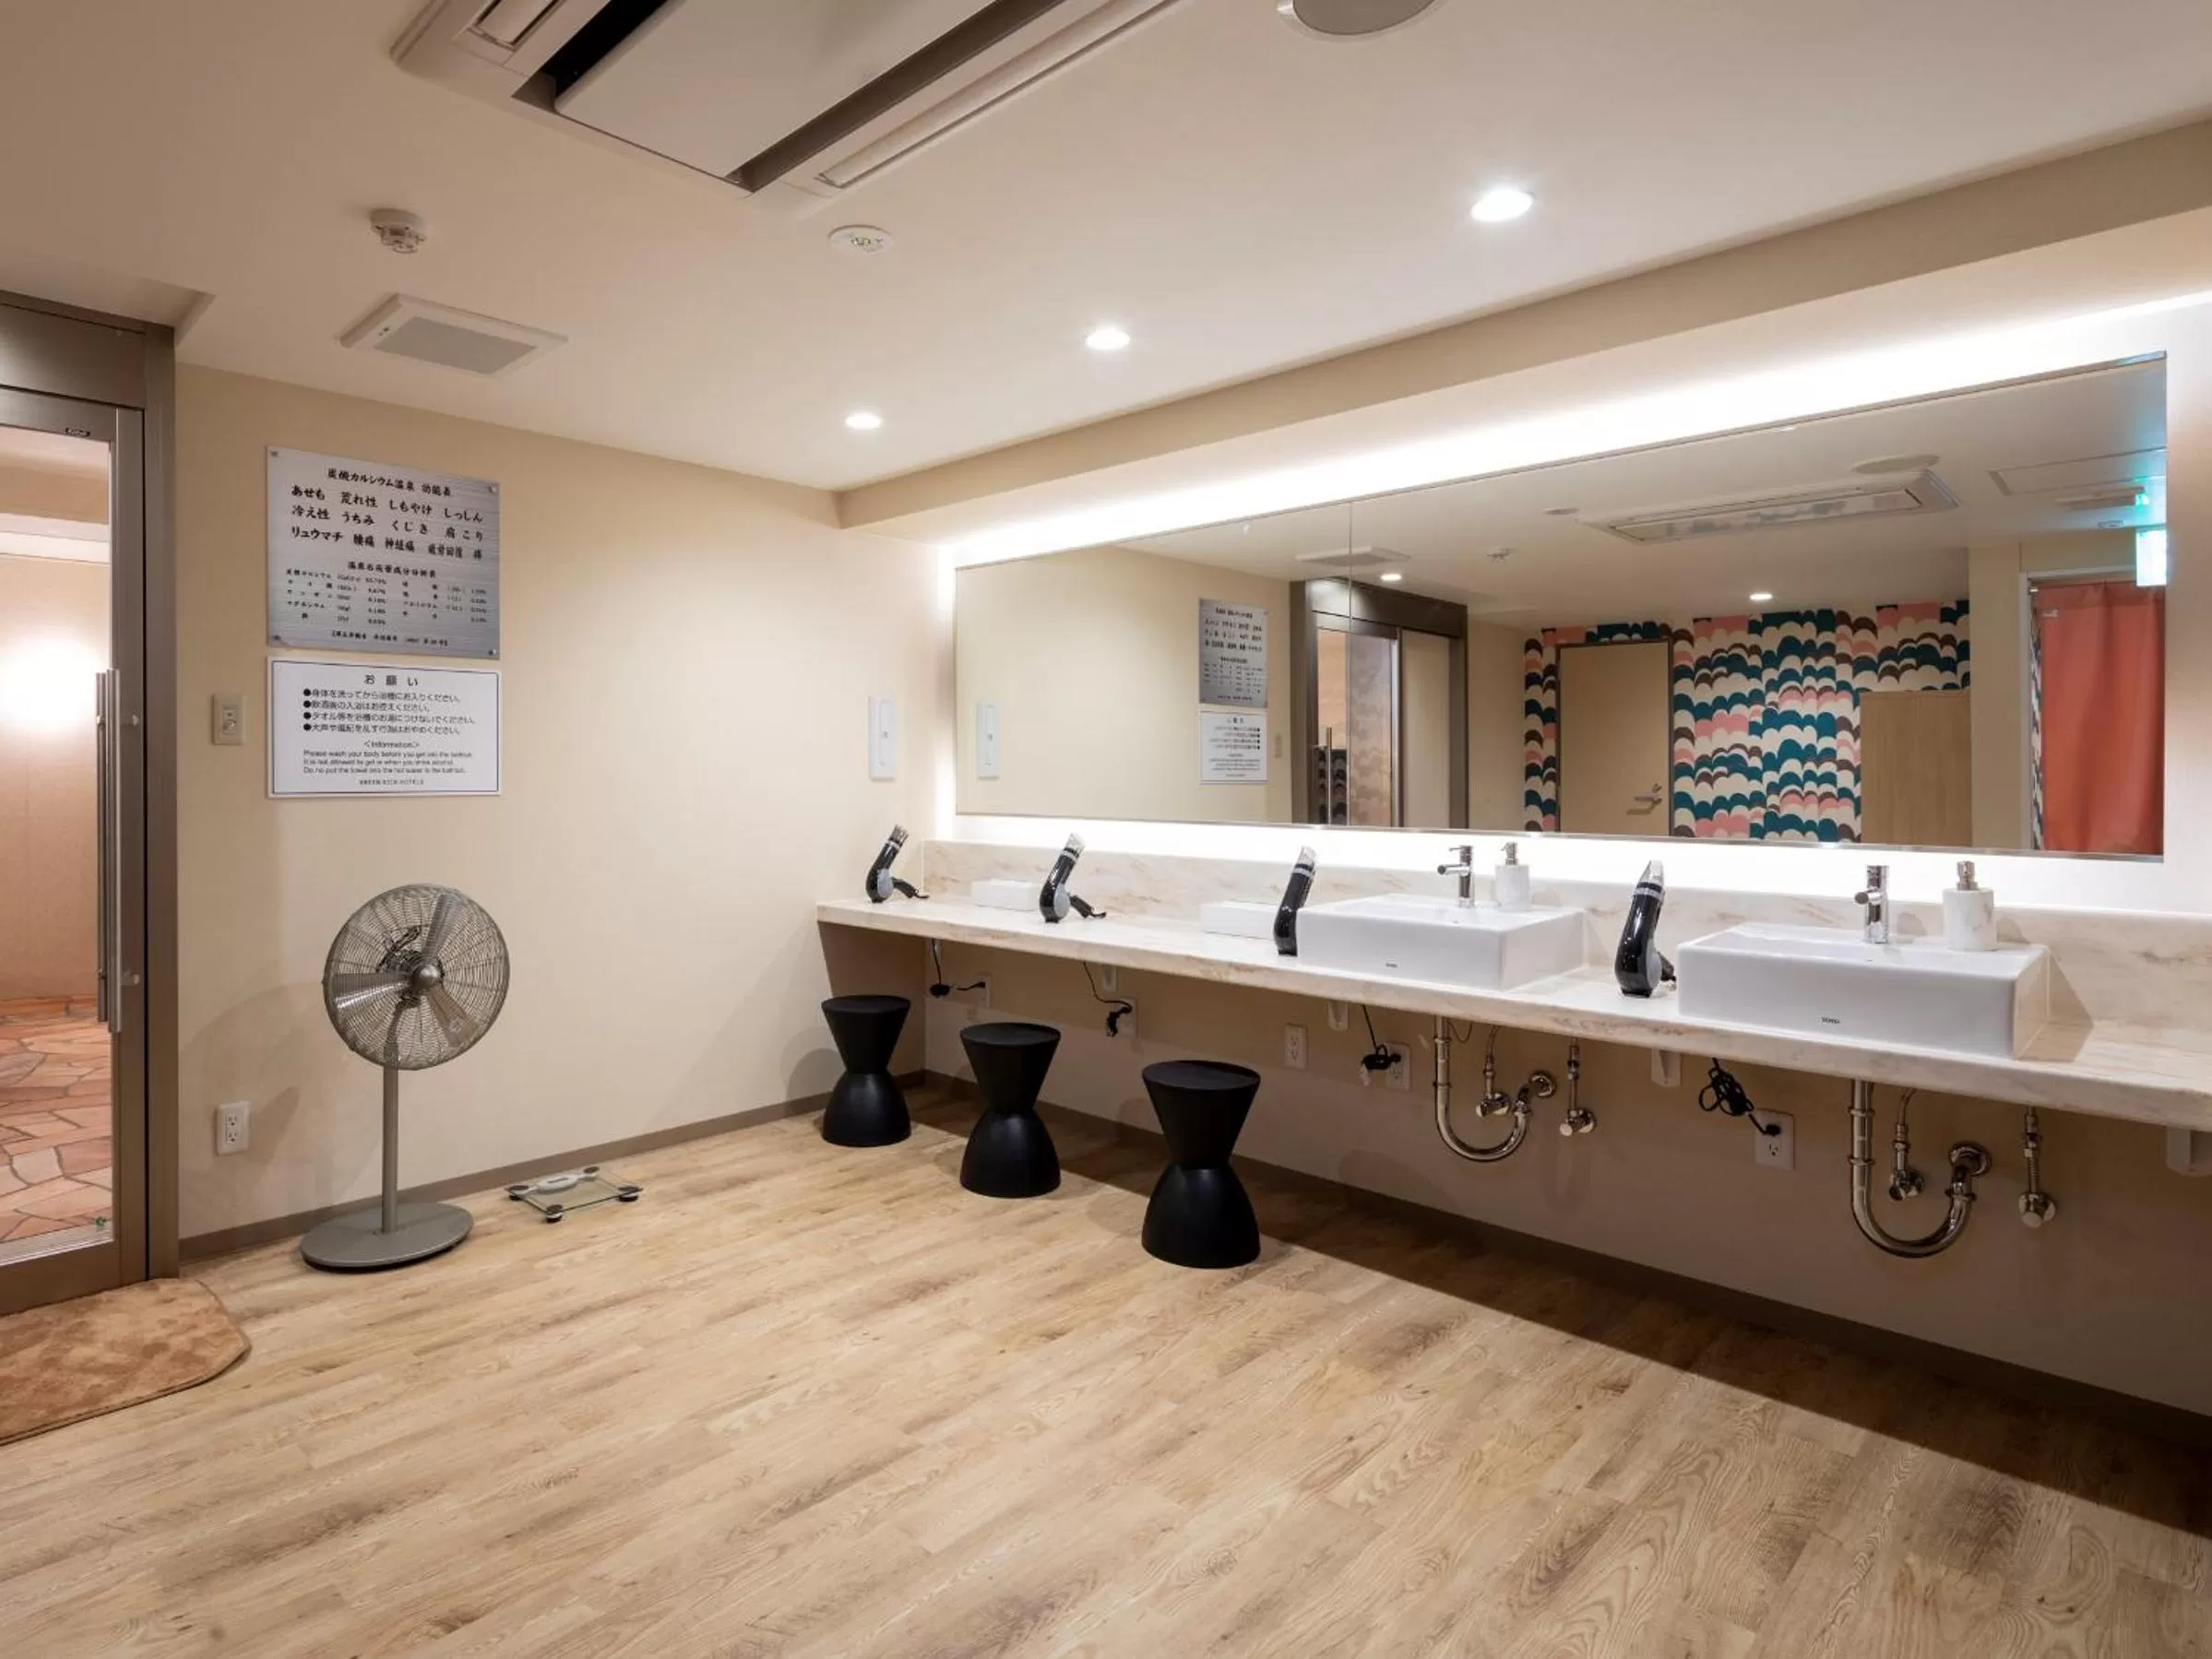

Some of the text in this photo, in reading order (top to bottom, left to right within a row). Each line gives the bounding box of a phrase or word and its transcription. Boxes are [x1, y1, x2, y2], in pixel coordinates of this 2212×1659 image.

[328, 468, 414, 491] 炭酸カルシウム温泉
[291, 484, 483, 523] あせも 荒れ性 しもやけ しっしん
[291, 505, 483, 542] 冷え性 うちみ くじき 肩こり
[291, 527, 343, 541] リュウマチ
[353, 534, 375, 547] 腰痛
[386, 538, 414, 552] 神経痛
[363, 674, 419, 686] お願い
